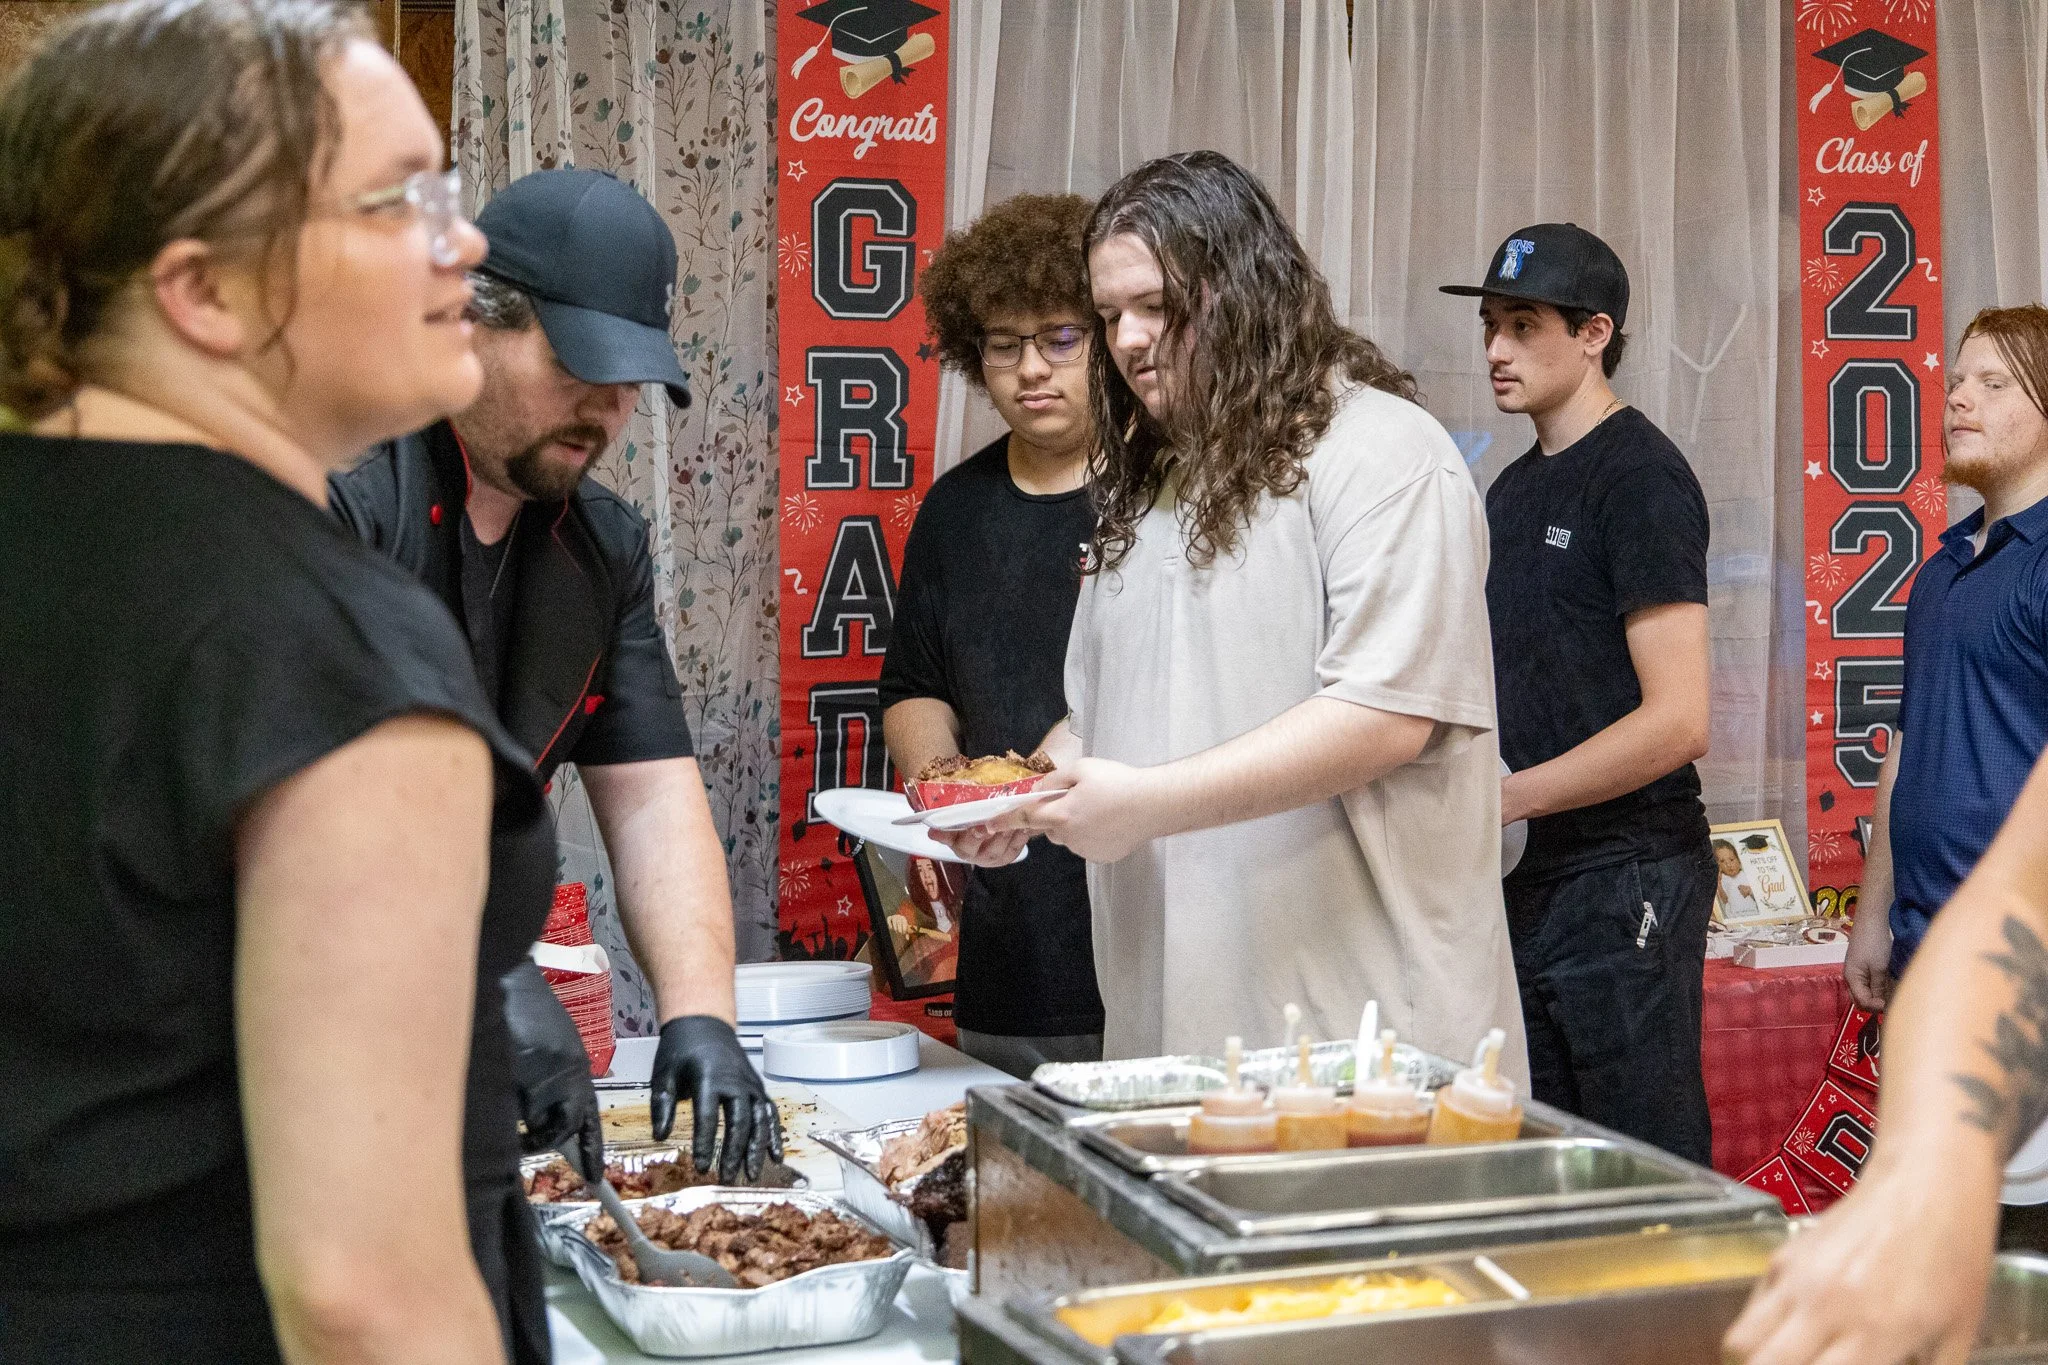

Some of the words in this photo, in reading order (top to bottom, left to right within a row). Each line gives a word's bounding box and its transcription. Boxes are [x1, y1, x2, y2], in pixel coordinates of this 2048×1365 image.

[789, 97, 938, 160] Congrats
[1815, 137, 1895, 175] Class
[1898, 139, 1929, 188] of
[1823, 201, 1923, 789] 2025
[1758, 874, 1785, 901] Grad
